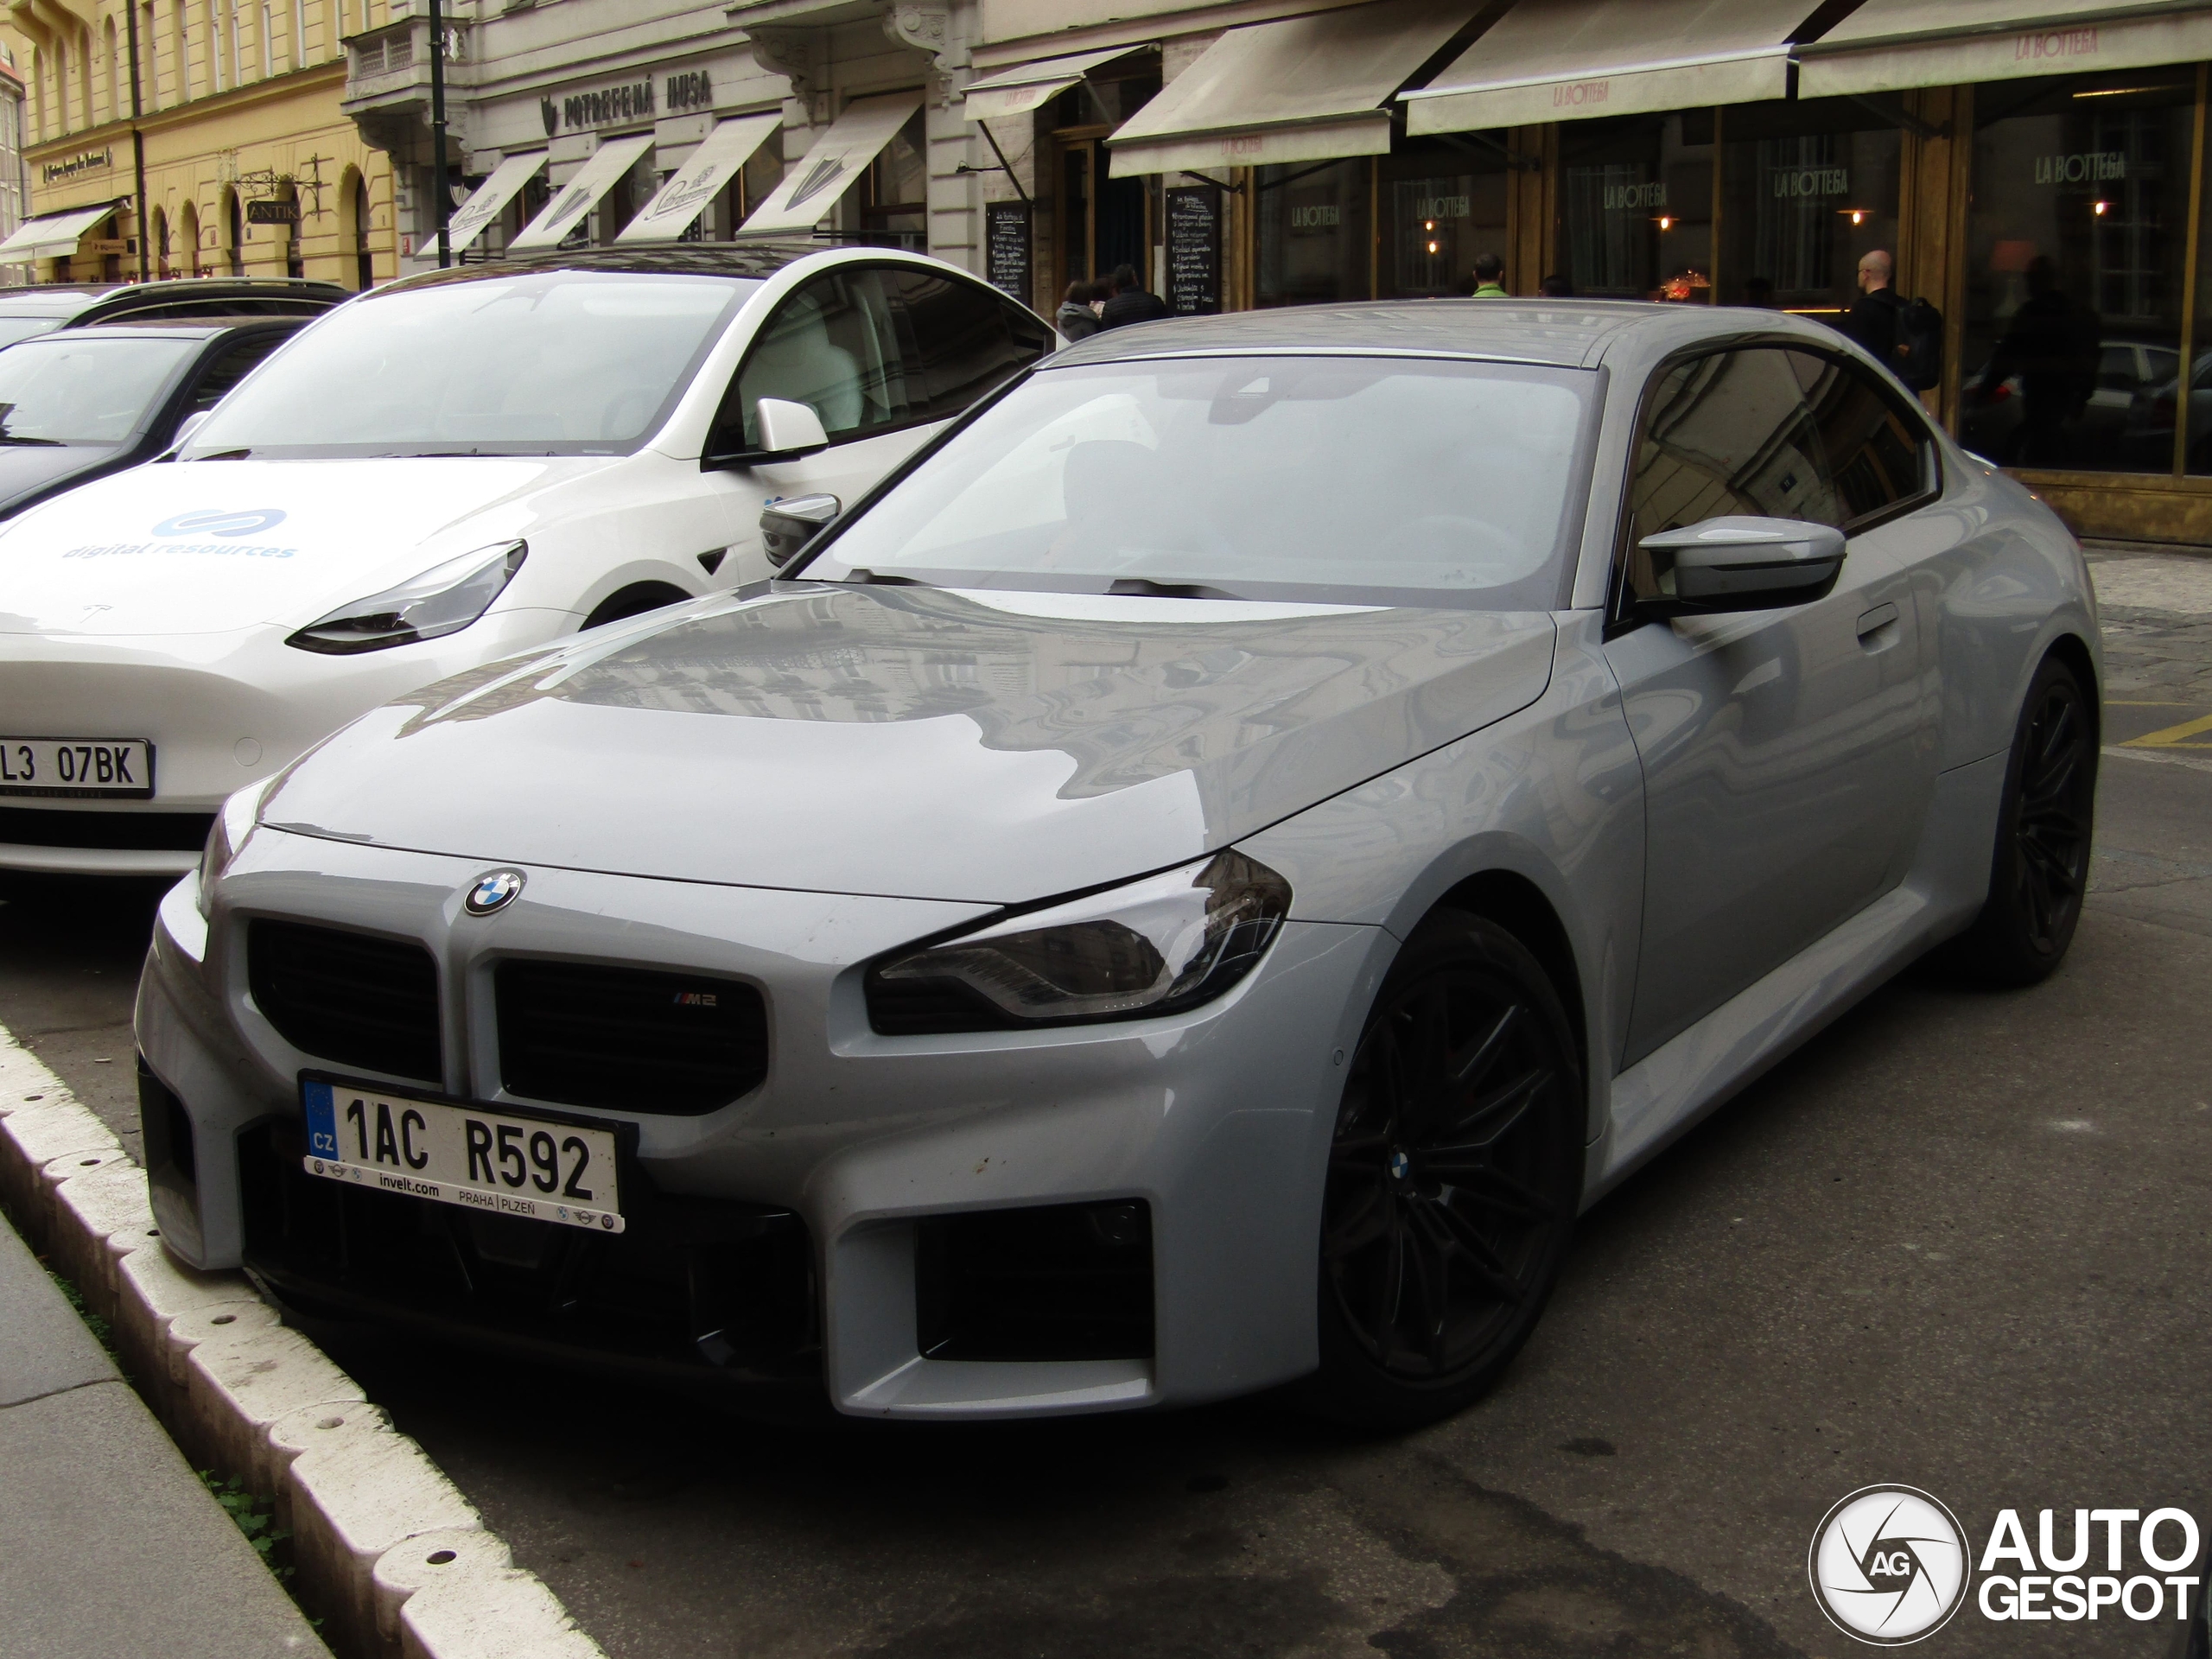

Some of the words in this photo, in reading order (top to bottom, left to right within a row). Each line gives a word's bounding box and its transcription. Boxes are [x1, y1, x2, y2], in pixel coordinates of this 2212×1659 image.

[2015, 35, 2030, 61] LA
[2033, 28, 2098, 58] BOTTEGA
[564, 73, 654, 128] POTREFENÁ
[667, 70, 713, 110] HUSA
[1553, 86, 1563, 107] LA
[1565, 81, 1609, 105] BOTTEGA
[2036, 156, 2051, 184] LA
[2055, 151, 2125, 182] BOTTEGA
[1774, 173, 1788, 197] LA
[1790, 168, 1848, 196] BOTTEGA
[1417, 199, 1427, 219] LA
[1428, 196, 1470, 219] BOTTEGA
[1604, 186, 1615, 208] LA
[1618, 183, 1667, 208] BOTTEGA
[249, 205, 299, 219] ANTIK
[1292, 207, 1301, 226] LA
[1303, 205, 1339, 226] BOTTEGA
[62, 542, 154, 559] digital
[154, 541, 299, 559] resources
[0, 744, 35, 781] L3
[58, 746, 135, 784] 07BK
[313, 1132, 334, 1152] CZ
[347, 1098, 429, 1170] 1AC
[465, 1118, 594, 1201] R592
[379, 1173, 440, 1198] invelt.com
[459, 1191, 495, 1208] PRAHA
[501, 1198, 536, 1216] PLZEŇ
